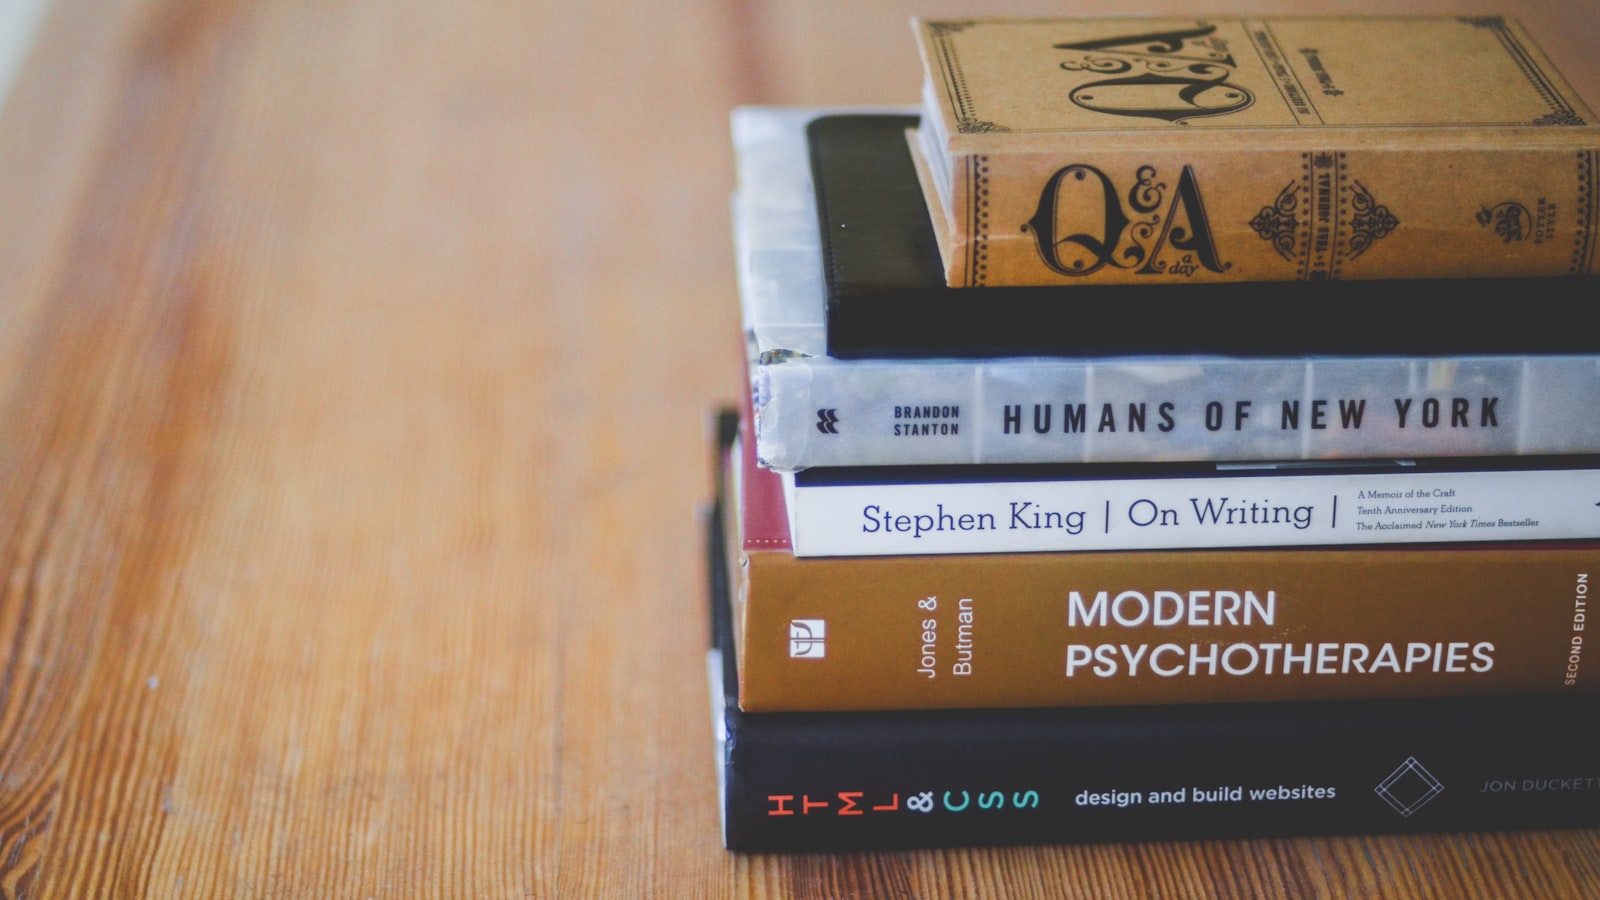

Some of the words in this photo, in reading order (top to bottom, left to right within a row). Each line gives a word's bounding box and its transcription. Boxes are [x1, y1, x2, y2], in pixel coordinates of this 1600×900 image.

[1318, 173, 1331, 223] JOURNAL
[1169, 262, 1198, 276] day
[894, 406, 960, 419] BRANDON
[1003, 402, 1175, 434] HUMANS
[1205, 400, 1252, 431] OF
[1281, 399, 1366, 430] NEW
[1394, 397, 1499, 428] YORK
[894, 423, 959, 436] STANTON
[1357, 490, 1366, 500] A
[1367, 490, 1403, 499] Memoir
[1405, 488, 1414, 499] of
[1416, 488, 1431, 498] the
[1432, 488, 1456, 498] Craft
[862, 504, 997, 538] Stephen
[1009, 502, 1086, 535] King
[1128, 499, 1178, 527] On
[1190, 497, 1314, 529] Writing
[1357, 505, 1382, 515] Tenth
[1384, 506, 1439, 516] Anniversary
[1440, 504, 1473, 513] Edition
[1356, 521, 1373, 531] The
[1374, 520, 1423, 531] Acclaimed
[1425, 519, 1447, 529] New
[1449, 519, 1468, 529] York
[1469, 518, 1496, 528] Times
[1497, 517, 1540, 528] Bestseller
[918, 596, 937, 611] &
[1067, 590, 1276, 627] MODERN
[1573, 573, 1588, 631] EDITION
[953, 598, 972, 676] Butman
[917, 619, 937, 678] Jones
[1065, 642, 1496, 678] PSYCHOTHERAPIES
[1564, 635, 1583, 686] SECOND
[1075, 789, 1142, 807] design
[1148, 788, 1187, 804] and
[1192, 786, 1243, 802] build
[1249, 785, 1336, 801] websites
[1480, 780, 1517, 793] JON
[906, 791, 934, 811] &
